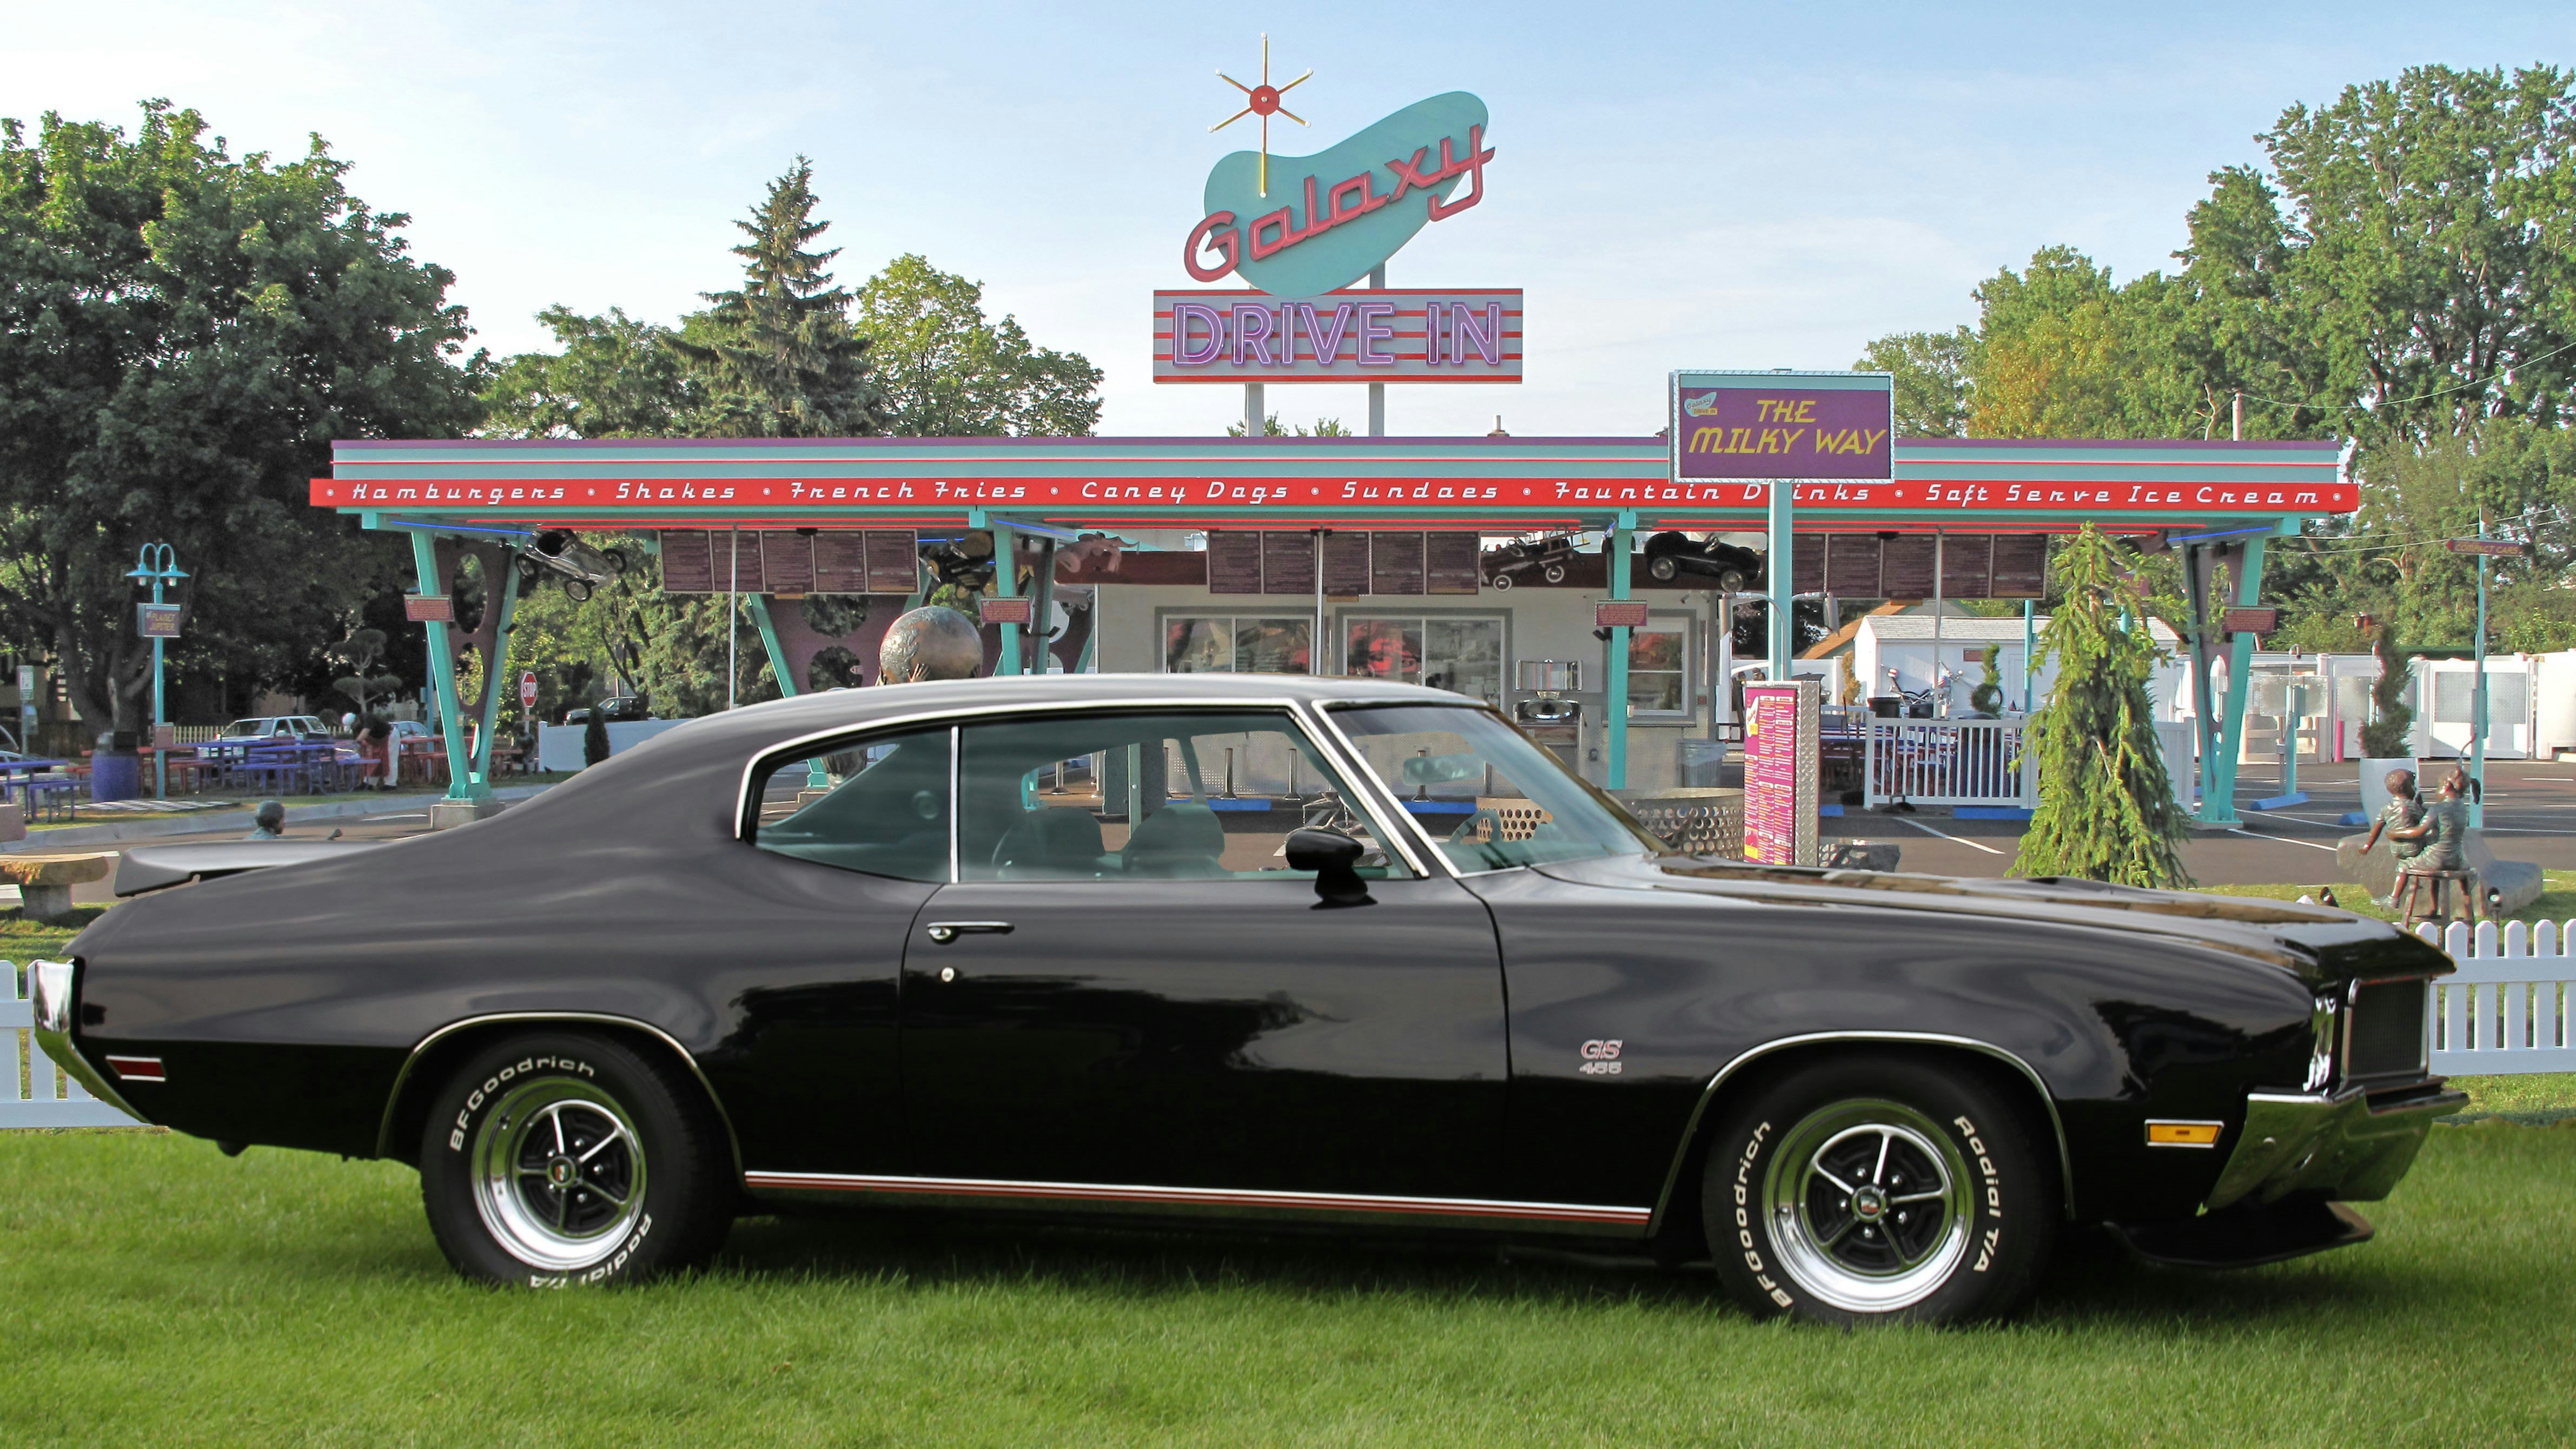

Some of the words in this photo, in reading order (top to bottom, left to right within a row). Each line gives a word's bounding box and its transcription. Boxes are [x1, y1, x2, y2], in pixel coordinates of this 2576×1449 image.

[1184, 123, 1496, 282] Galaxy
[1173, 302, 1395, 367] DRIVE
[1426, 301, 1504, 367] IN
[1757, 400, 1816, 423] THE
[1688, 427, 1805, 454] MILKY
[1815, 428, 1887, 455] WAY
[352, 483, 565, 505] Hamburgers
[615, 482, 735, 499] Shakes
[790, 481, 914, 499] French
[934, 481, 1026, 498] Fries
[1341, 481, 1498, 498] Sundaes
[1742, 484, 1869, 500] Dinks
[2005, 484, 2111, 502] Serve
[2127, 485, 2182, 503] Ice
[2196, 486, 2319, 504] Cream
[2455, 544, 2494, 553] COMPACT
[2495, 546, 2519, 554] CARS
[523, 682, 537, 698] STOP
[1581, 1039, 1623, 1060] GS
[449, 1056, 595, 1152] BFGoodrich
[1953, 1115, 2001, 1218] Radial
[1733, 1121, 1793, 1308] BFGoodrich
[581, 1213, 653, 1286] Radial
[1973, 1228, 2000, 1273] T/A
